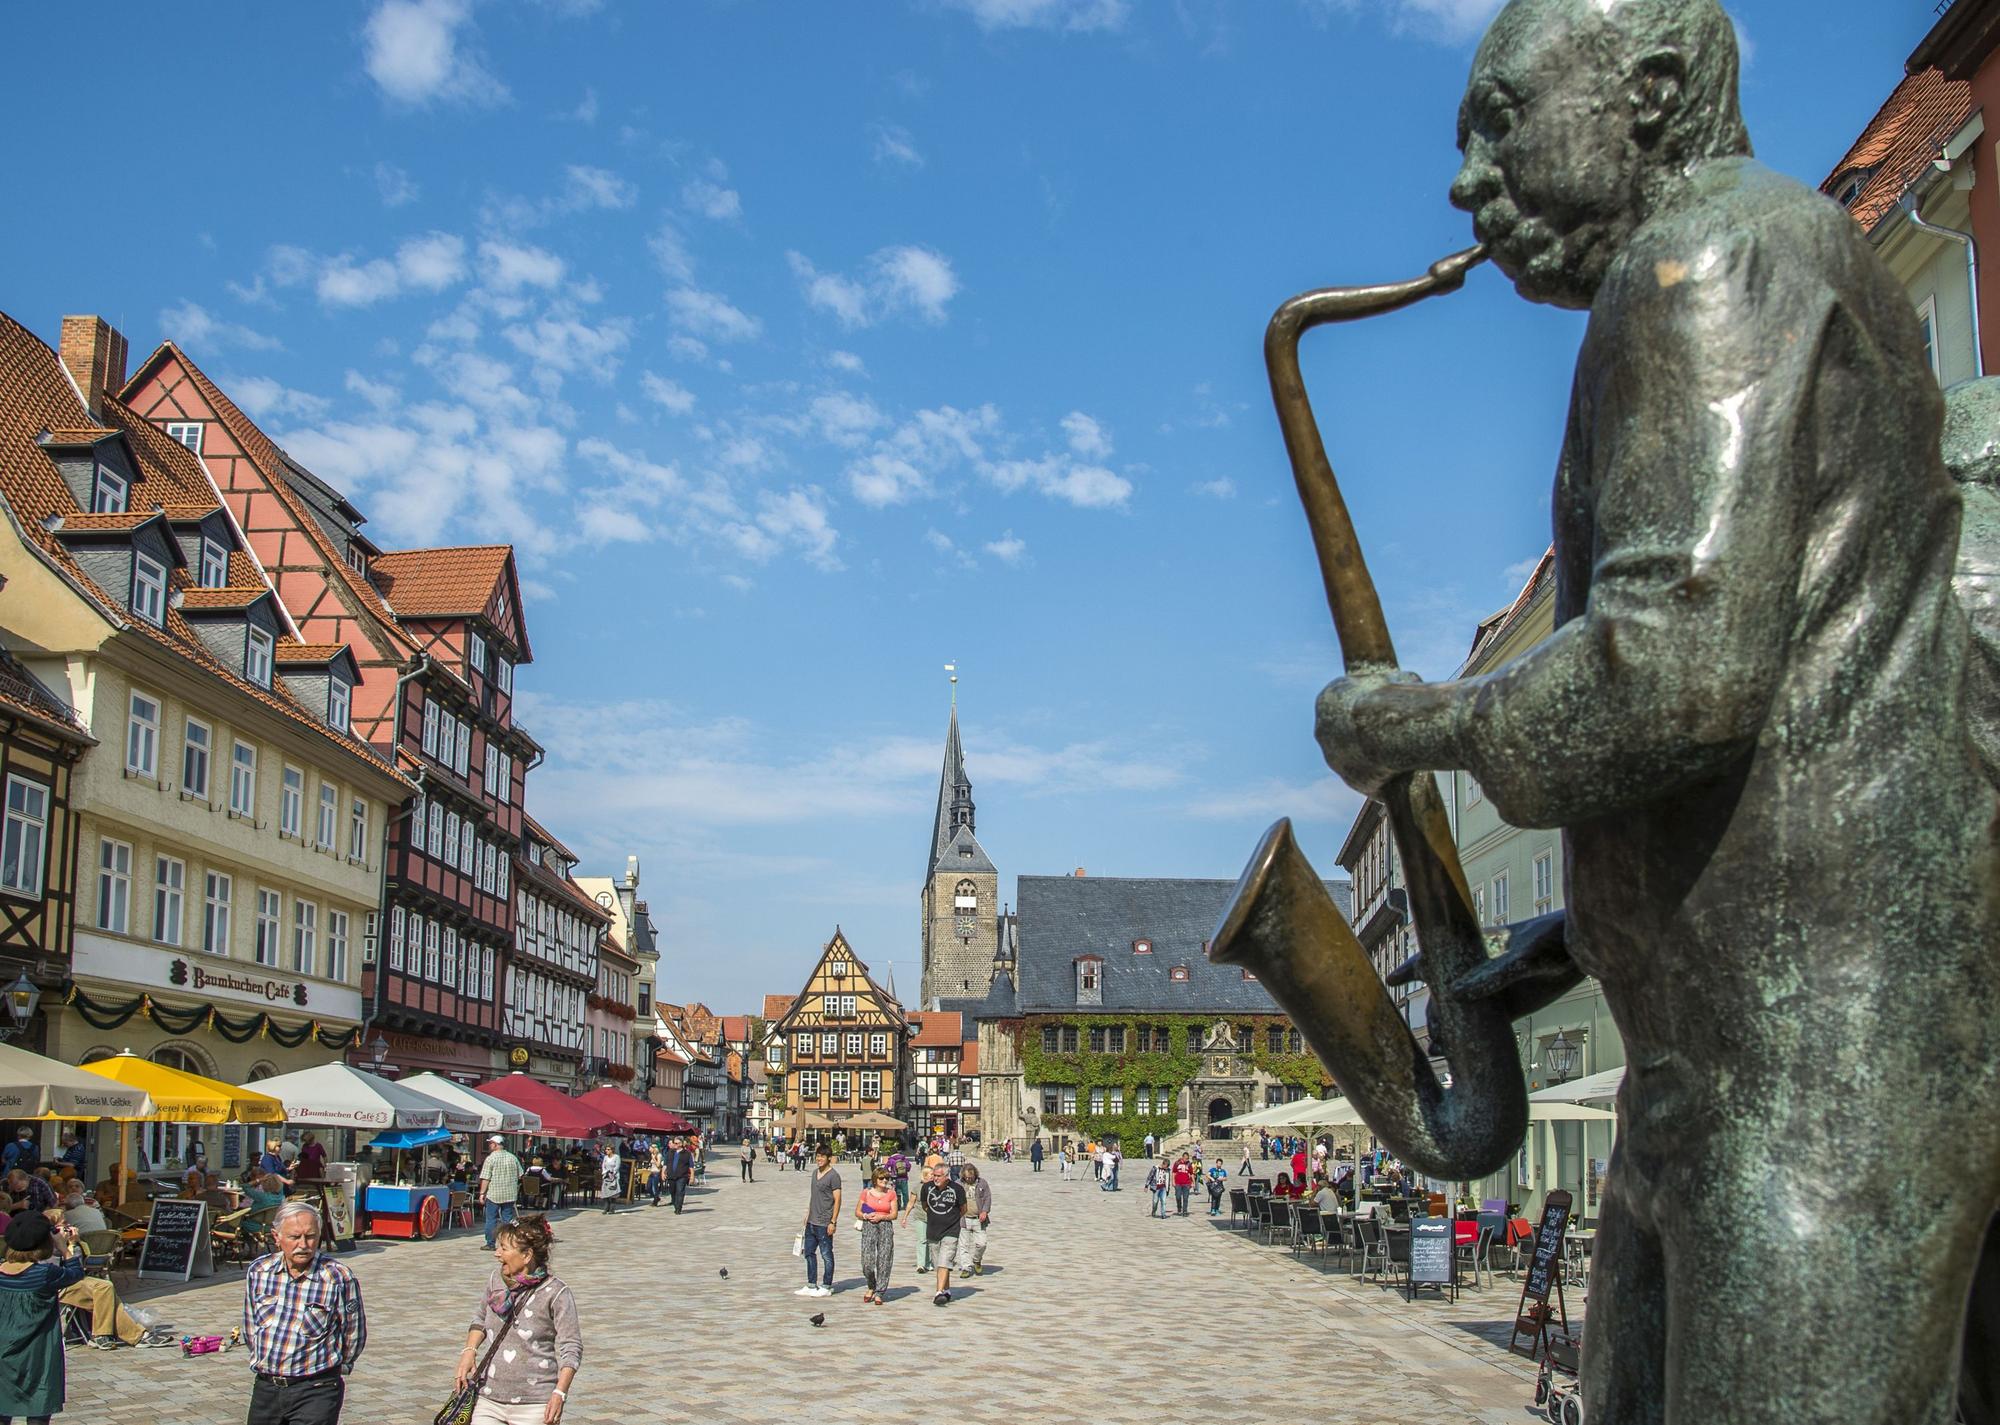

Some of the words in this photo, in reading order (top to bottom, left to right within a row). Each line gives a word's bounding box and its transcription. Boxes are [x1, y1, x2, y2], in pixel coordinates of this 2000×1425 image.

[193, 966, 264, 994] Baumkuchen
[264, 980, 289, 1001] Café
[110, 1097, 132, 1107] Gelbke
[156, 1103, 180, 1113] kerei
[182, 1104, 192, 1113] M.
[194, 1104, 227, 1115] Gelbke
[300, 1107, 351, 1119] Baumkuchen
[353, 1110, 375, 1120] Café
